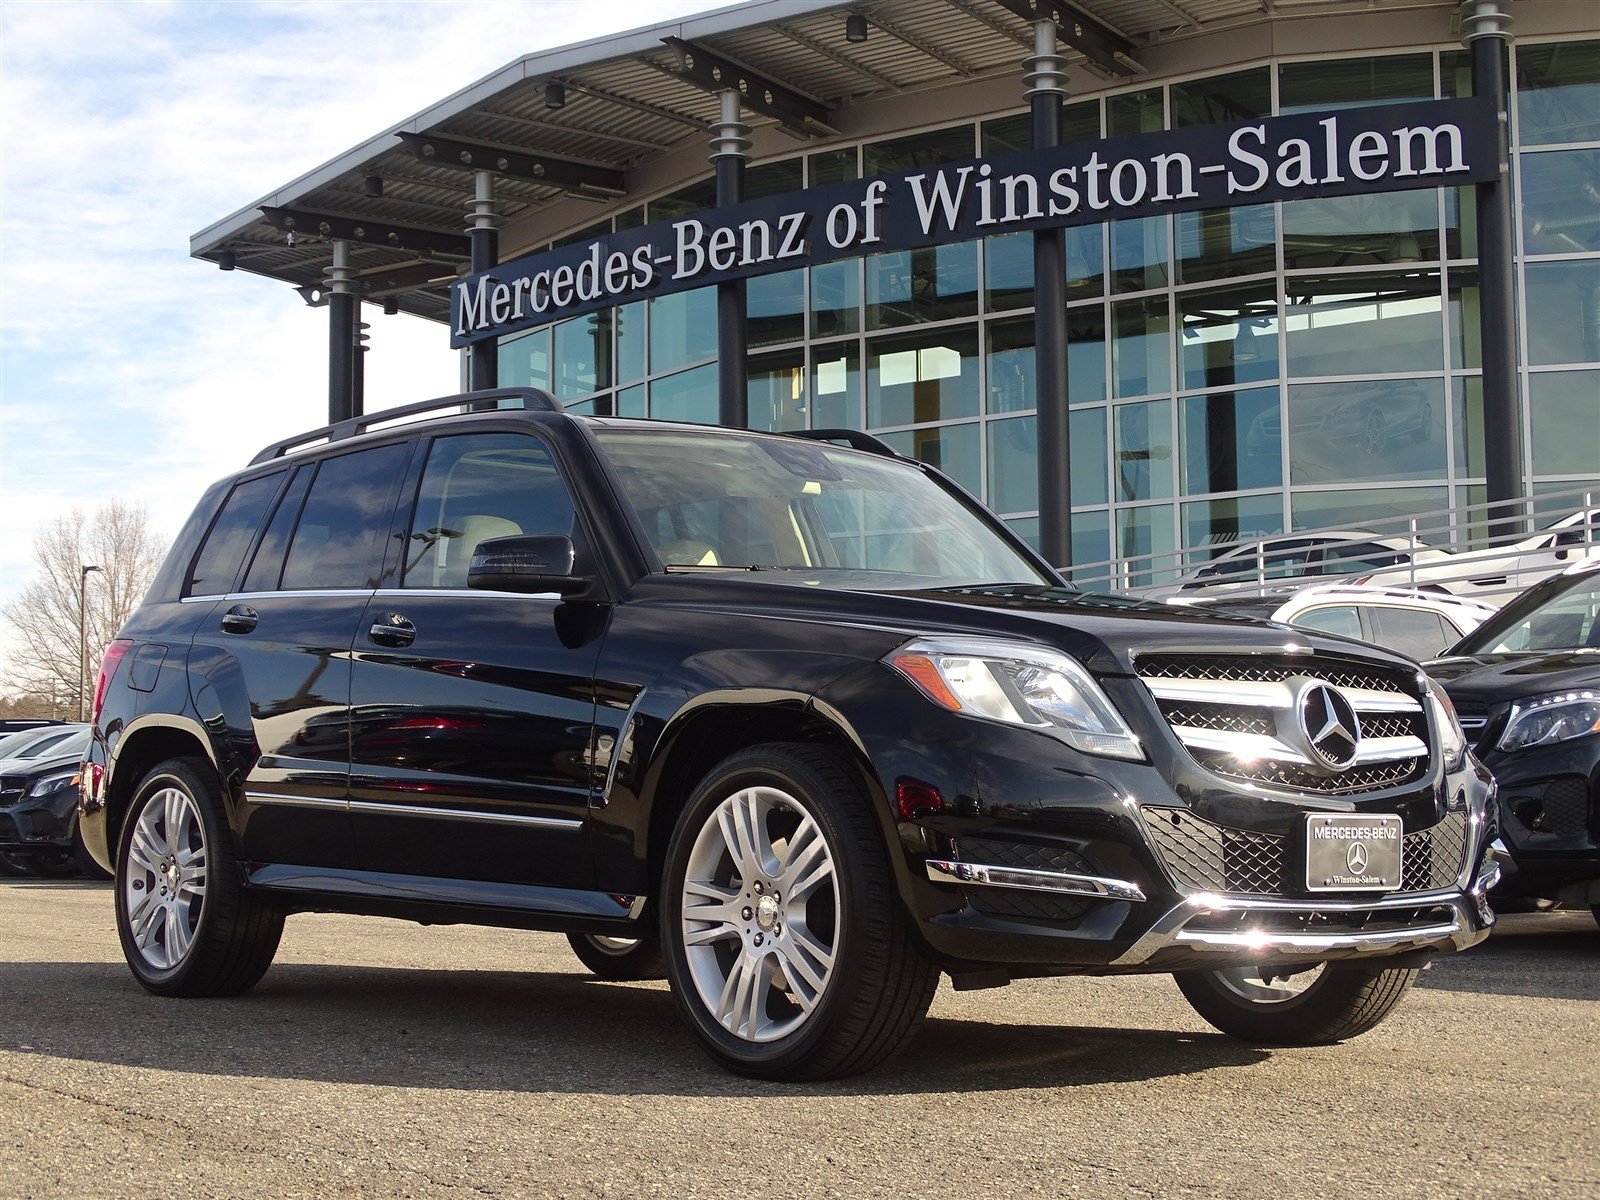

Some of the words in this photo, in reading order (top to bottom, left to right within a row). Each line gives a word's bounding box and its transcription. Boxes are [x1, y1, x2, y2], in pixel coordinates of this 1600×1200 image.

[455, 210, 805, 337] Mercedes-Benz
[825, 180, 887, 249] of
[904, 116, 1470, 235] Winston-Salem
[1314, 826, 1398, 840] MERCEDES-BENZ
[1332, 874, 1380, 885] Winston-Salem
